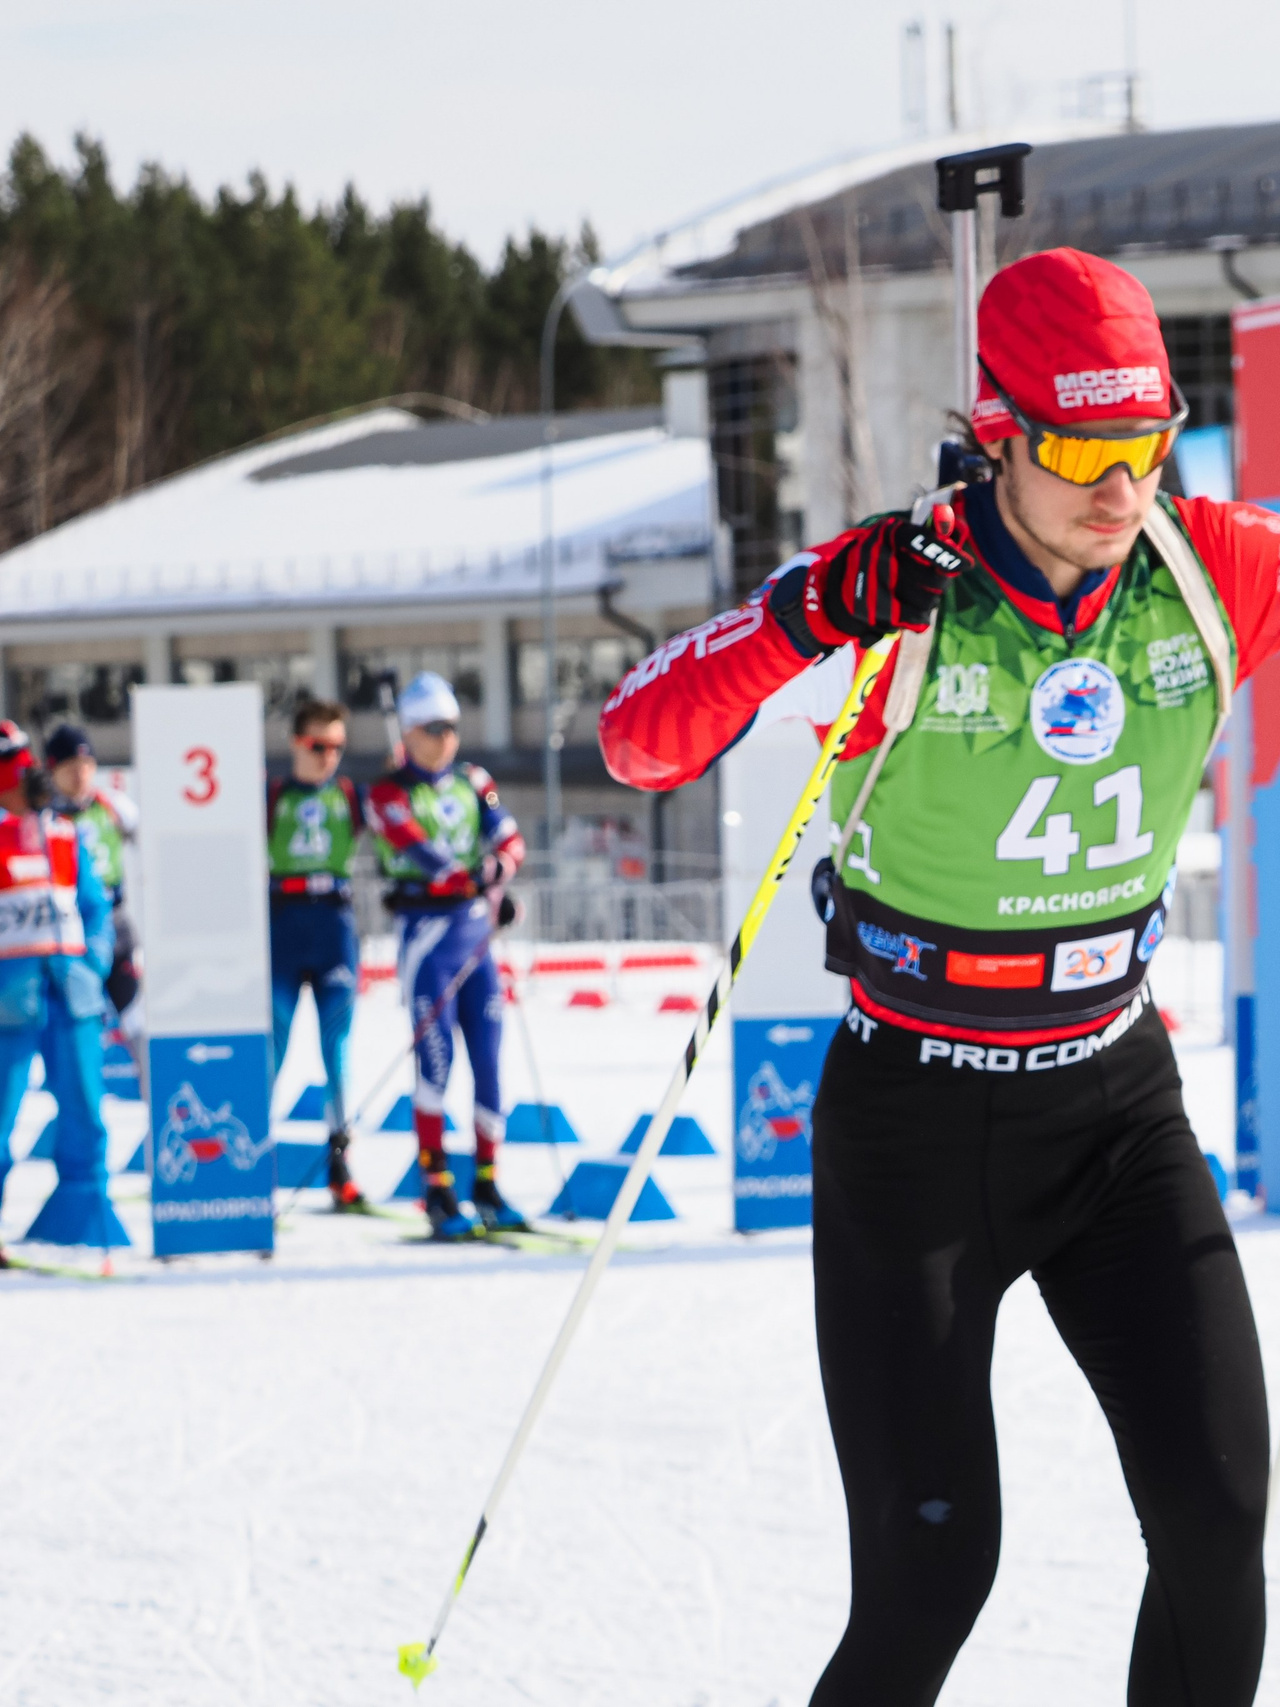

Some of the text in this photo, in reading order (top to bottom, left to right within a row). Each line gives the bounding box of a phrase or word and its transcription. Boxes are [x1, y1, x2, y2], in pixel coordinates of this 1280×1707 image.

[911, 534, 961, 571] LEKI
[182, 746, 221, 806] 3
[995, 765, 1154, 876] 41
[998, 874, 1147, 915] КРАСНОЯРСК
[920, 1037, 1019, 1072] PRO
